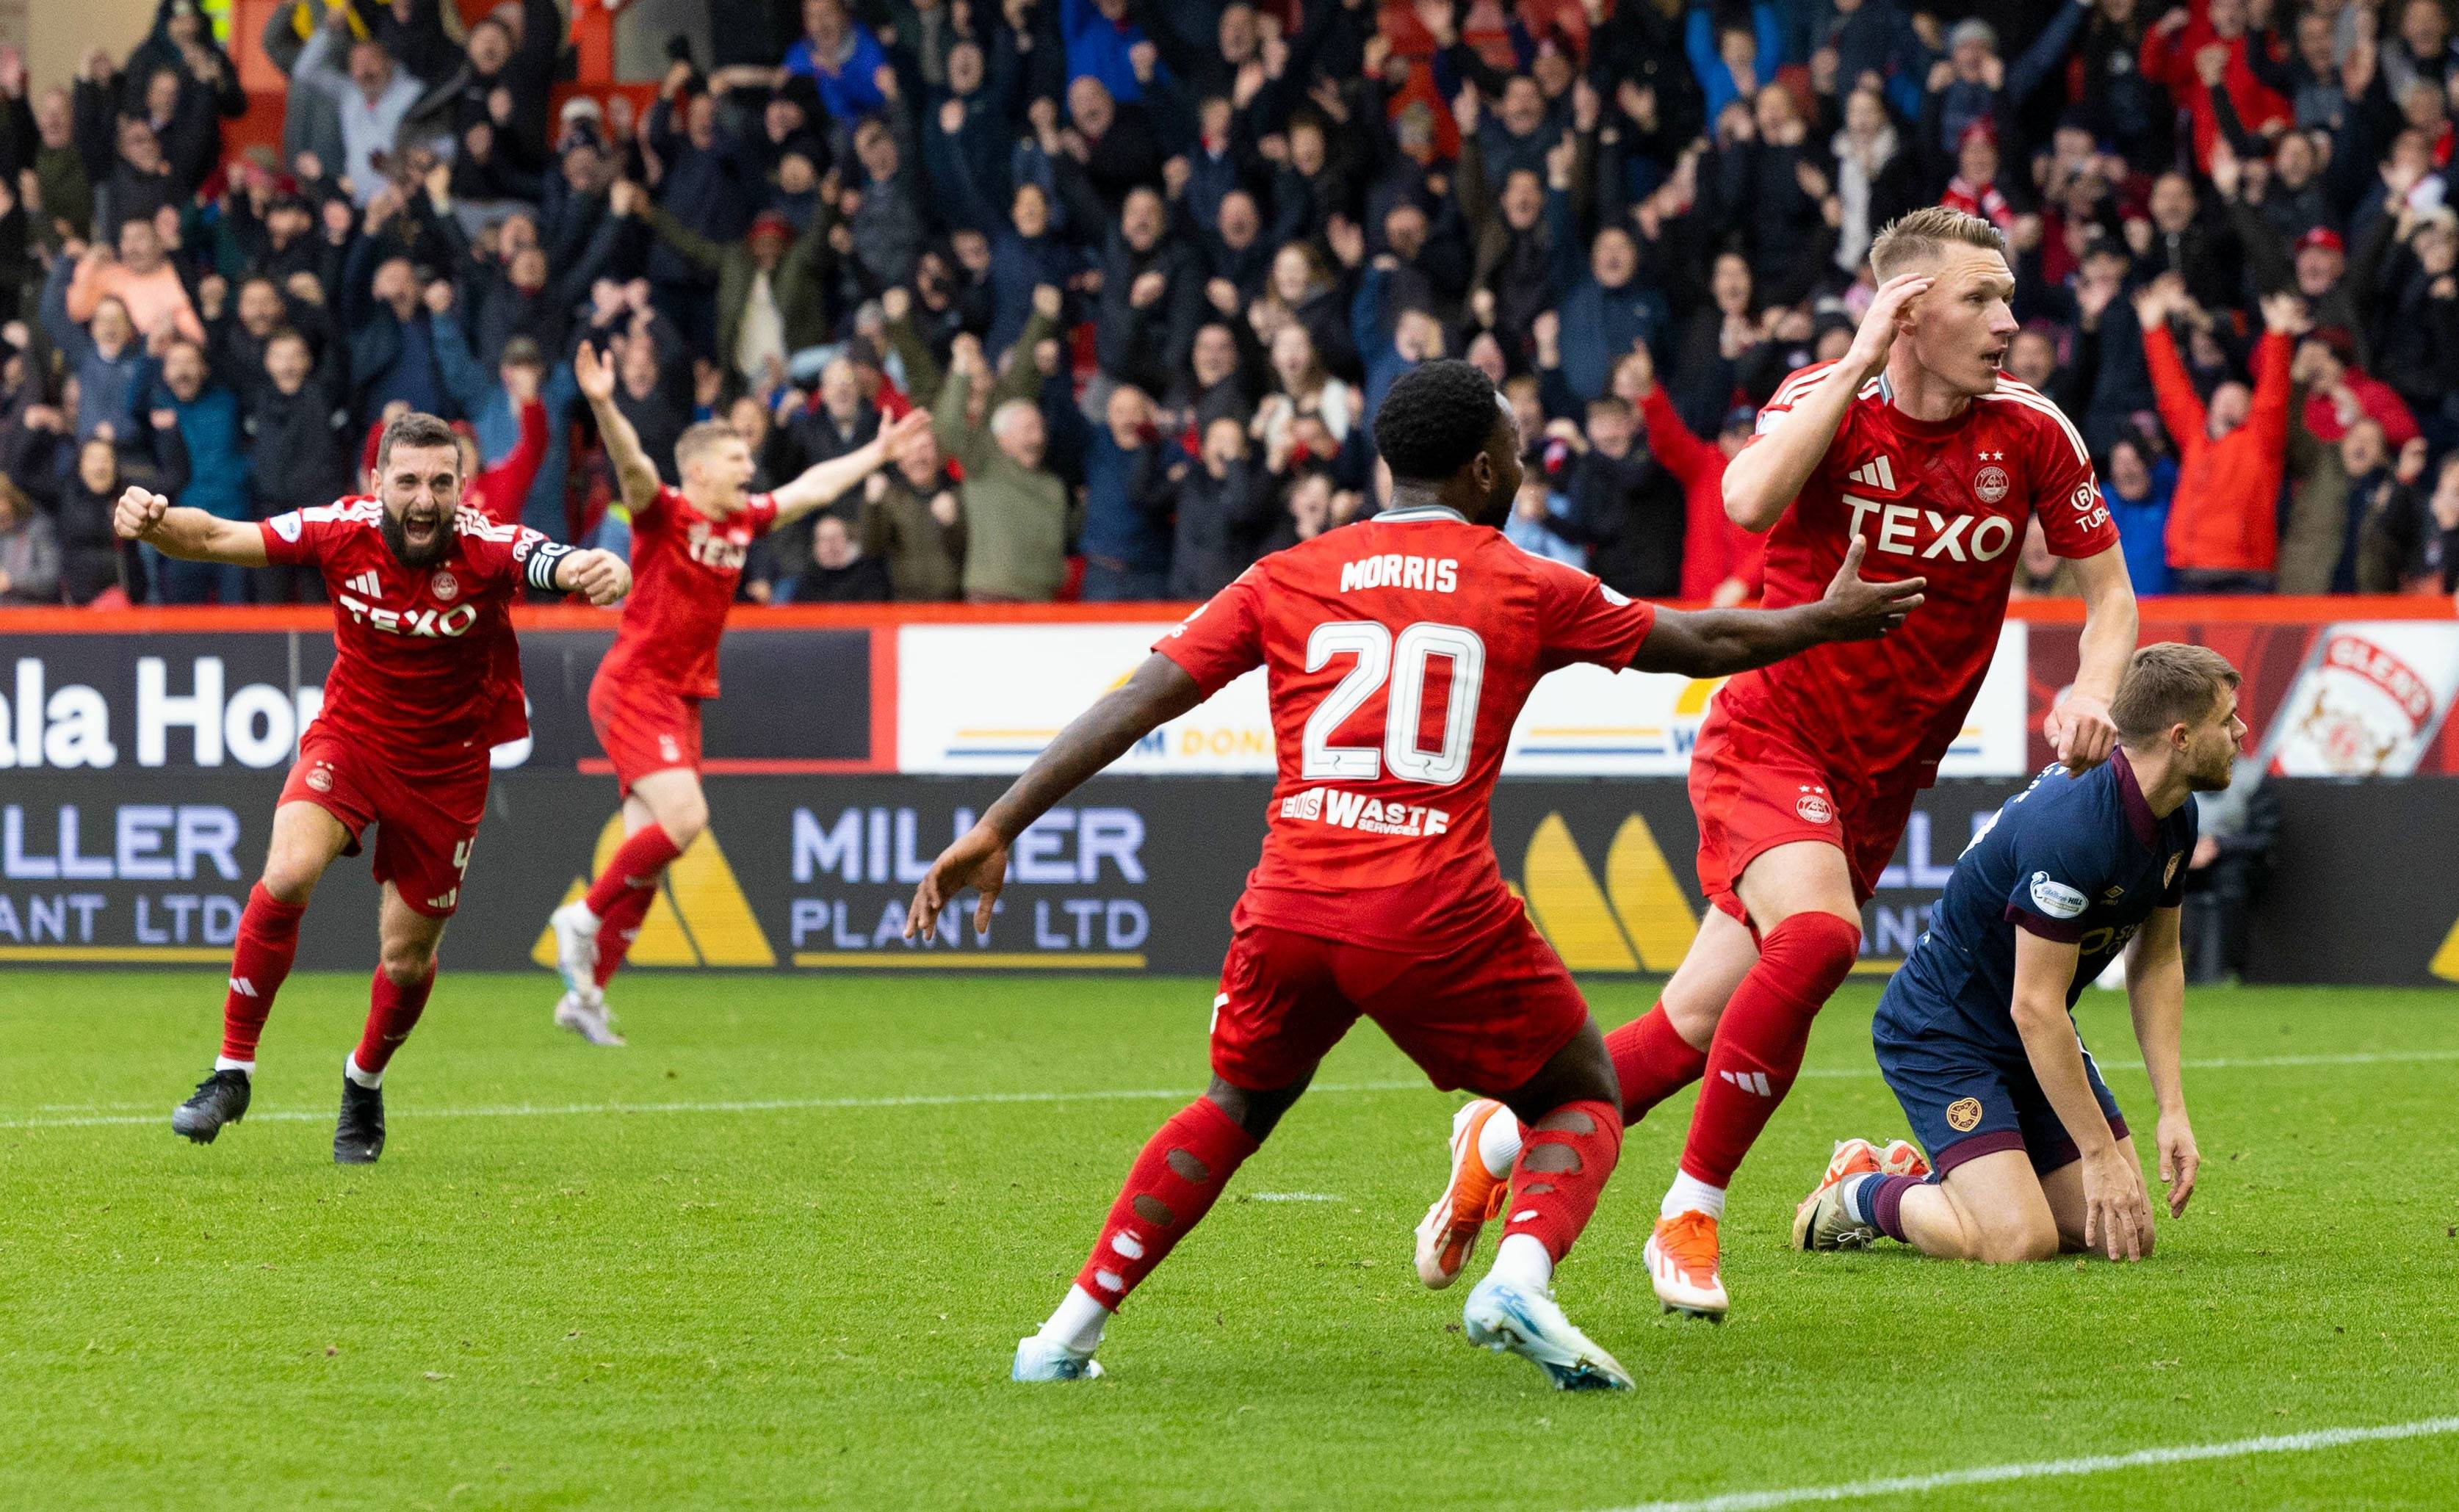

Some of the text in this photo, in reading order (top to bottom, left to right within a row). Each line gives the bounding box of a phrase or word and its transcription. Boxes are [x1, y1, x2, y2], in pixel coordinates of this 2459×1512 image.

[1842, 493, 2013, 563] TEXO
[1340, 554, 1458, 593] MORRIS
[339, 594, 477, 637] TEXO
[0, 658, 118, 769] la
[1302, 621, 1486, 786] 20
[1182, 728, 1277, 756] DON
[1326, 789, 1450, 836] WASTE
[1357, 818, 1421, 837] SERVICES
[453, 836, 475, 882] 4
[134, 894, 243, 944] LTD
[1035, 899, 1150, 949] LTD
